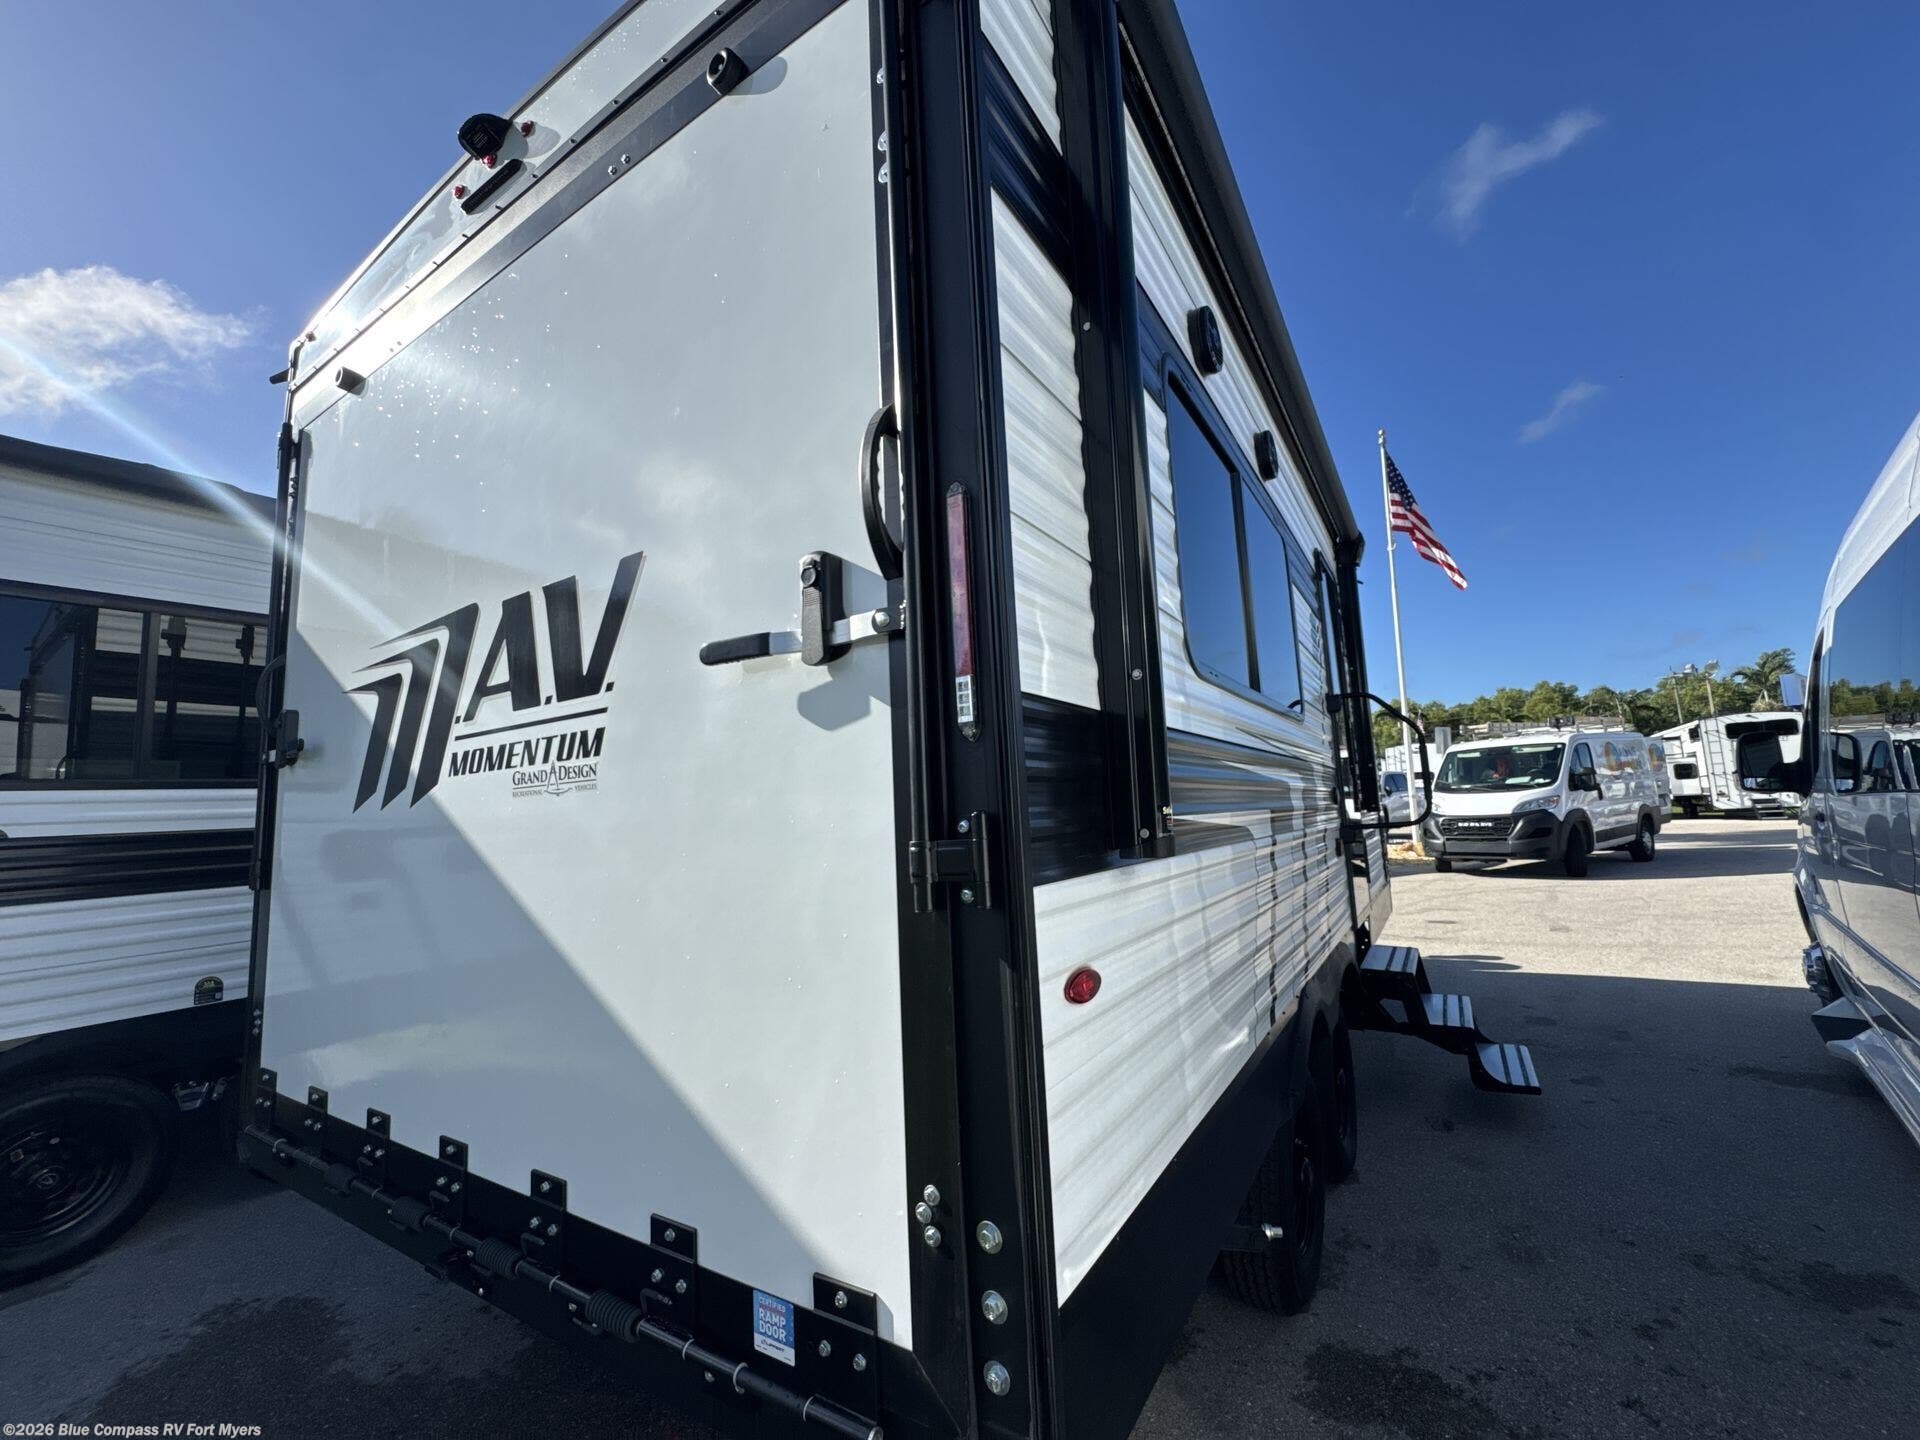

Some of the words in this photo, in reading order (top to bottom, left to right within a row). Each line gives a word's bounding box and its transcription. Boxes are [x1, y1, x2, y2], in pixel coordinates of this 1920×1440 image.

[448, 726, 606, 778] MOMENTUM
[759, 1307, 787, 1328] RAMP
[759, 1319, 787, 1342] DOOR
